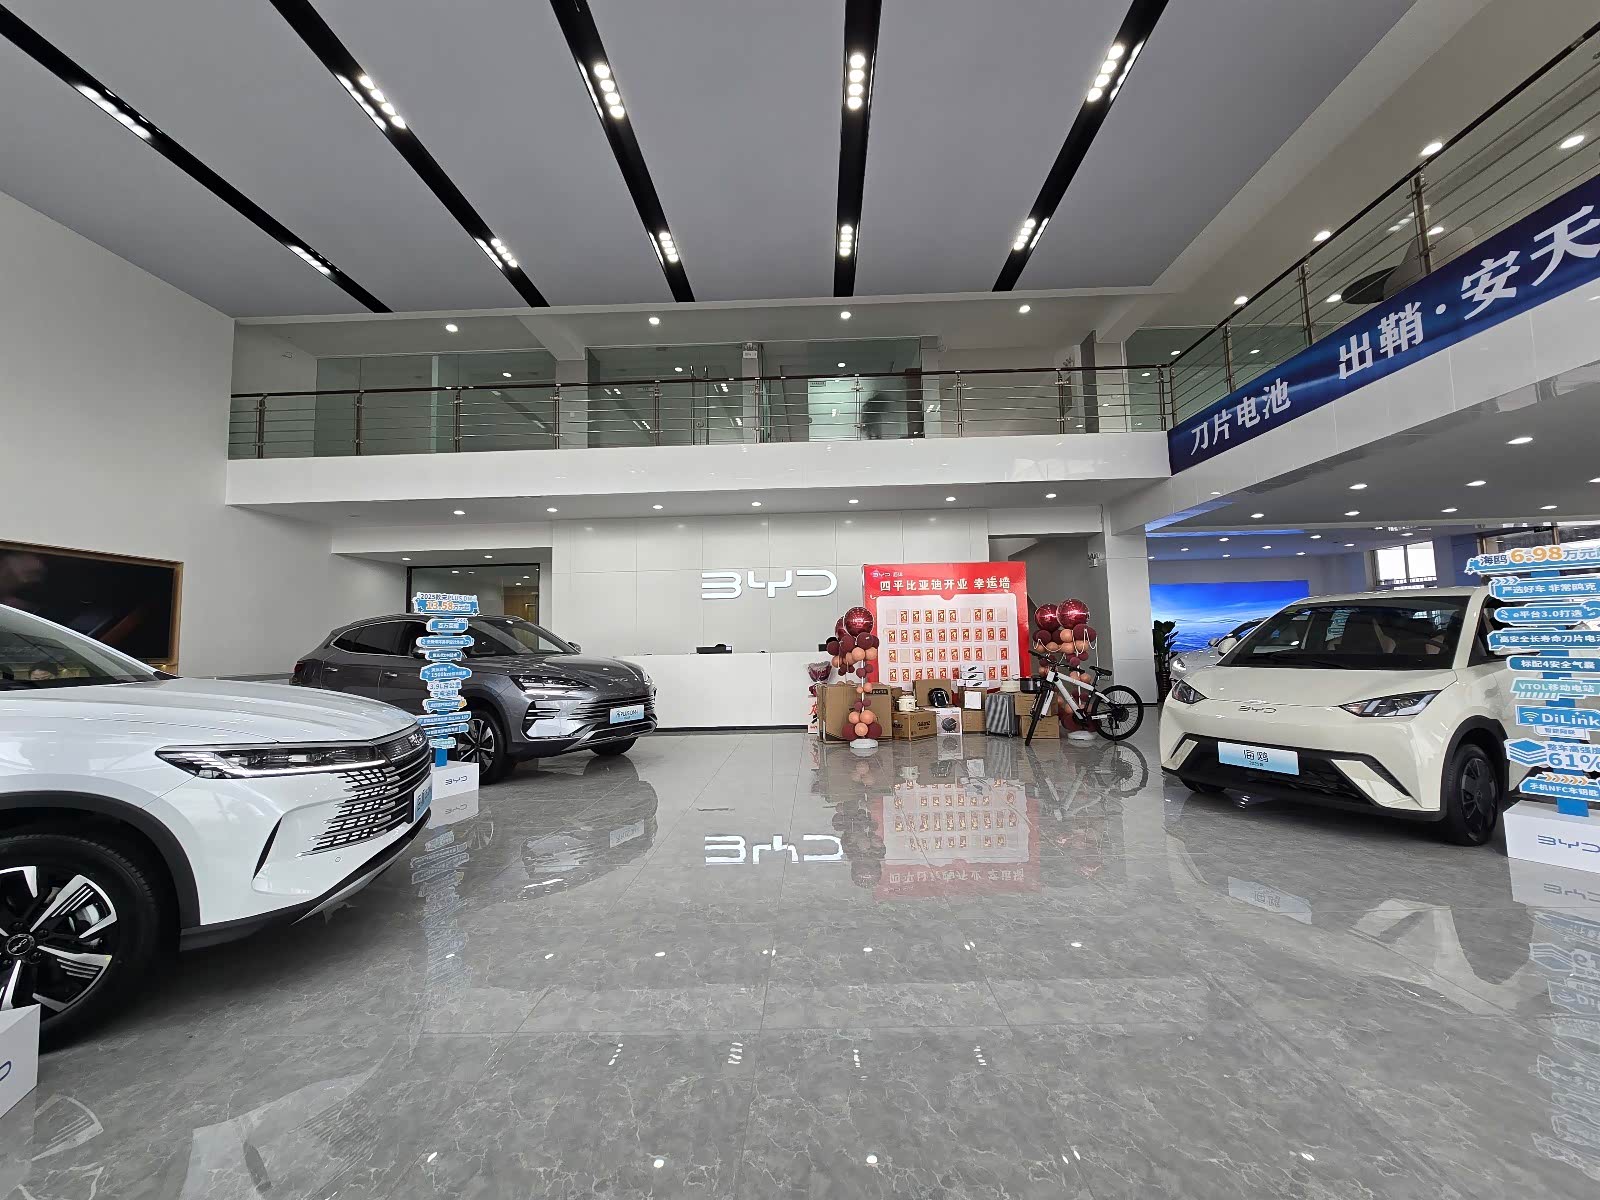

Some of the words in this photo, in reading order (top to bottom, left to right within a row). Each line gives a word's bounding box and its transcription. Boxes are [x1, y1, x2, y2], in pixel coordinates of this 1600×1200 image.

[1190, 378, 1291, 456] 刀片电池
[701, 570, 838, 599] BYD
[880, 579, 968, 591] 四平比亚迪开业
[974, 576, 1010, 589] 幸运墙
[1502, 585, 1546, 594] 严选好车
[1521, 660, 1595, 669] 标配4安全气囊
[1519, 683, 1595, 692] VTOL移动电站
[1238, 705, 1276, 713] BYD
[1542, 712, 1600, 726] DiLink
[1243, 749, 1269, 762] 海鸥
[1550, 753, 1600, 769] 61%
[445, 775, 467, 785] BYD
[1537, 834, 1600, 853] BYD
